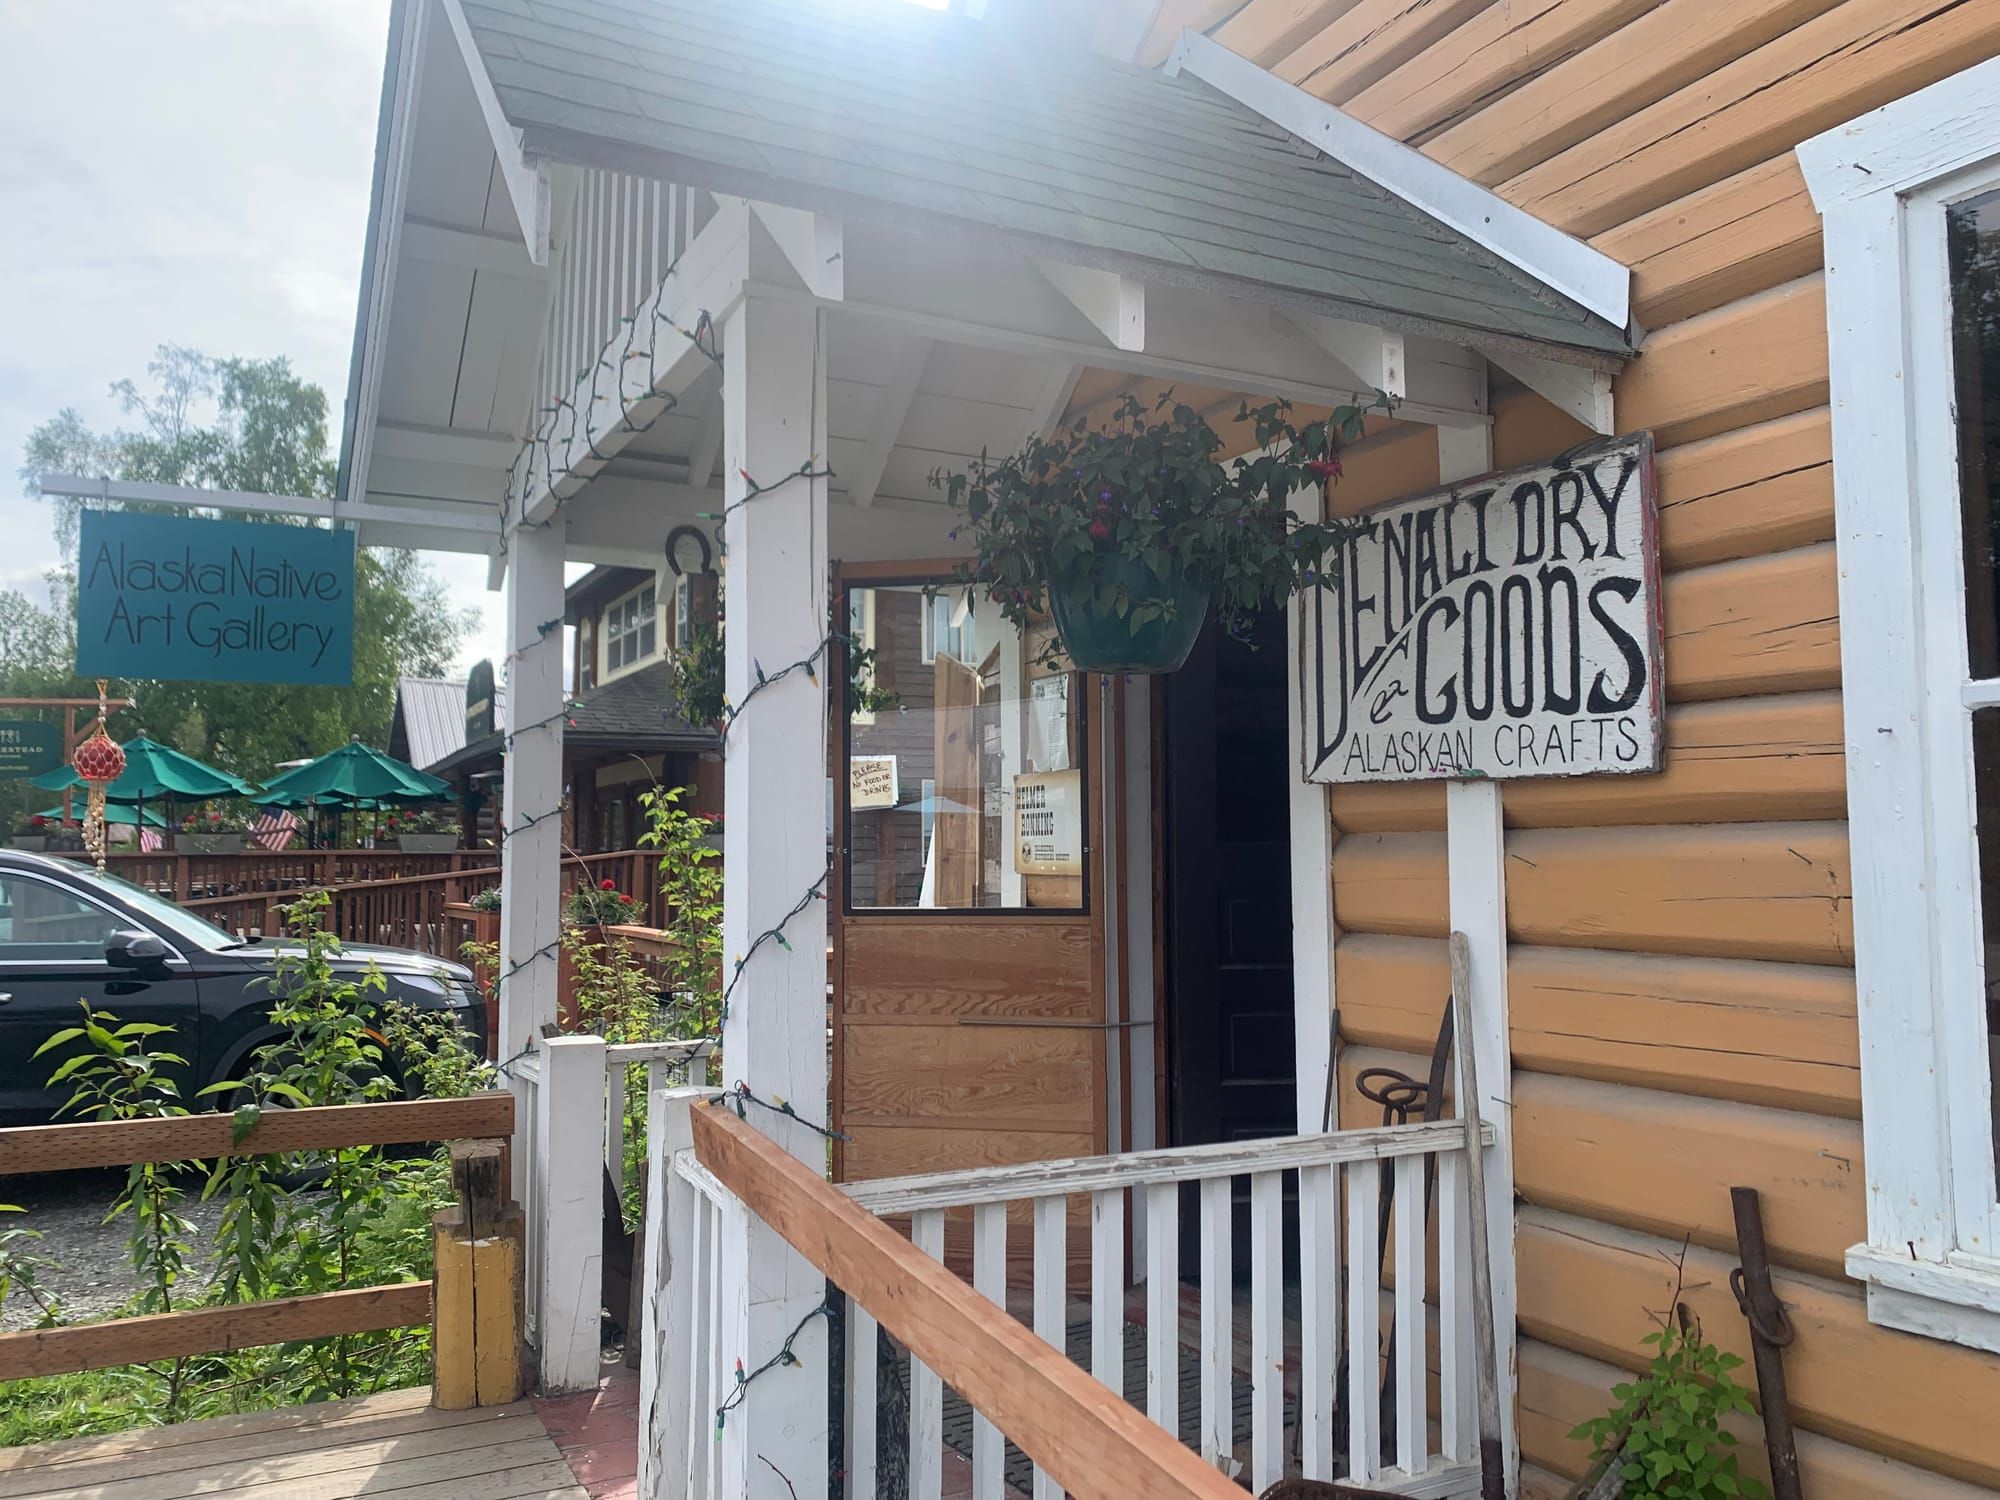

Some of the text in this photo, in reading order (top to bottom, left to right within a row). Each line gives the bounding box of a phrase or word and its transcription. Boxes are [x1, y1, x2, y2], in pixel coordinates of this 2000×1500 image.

[88, 540, 342, 601] Alaska Native
[104, 596, 334, 668] Art Gallery
[1308, 456, 1638, 778] DENALI DRY
[1416, 562, 1647, 725] GOODS
[1343, 716, 1640, 776] ALASKAN CRAFTS
[852, 762, 883, 777] PLEASE
[861, 784, 891, 795] DRINKS
[864, 776, 881, 786] FOOD
[1016, 785, 1045, 810] HELMER
[1021, 811, 1053, 836] RONNING
